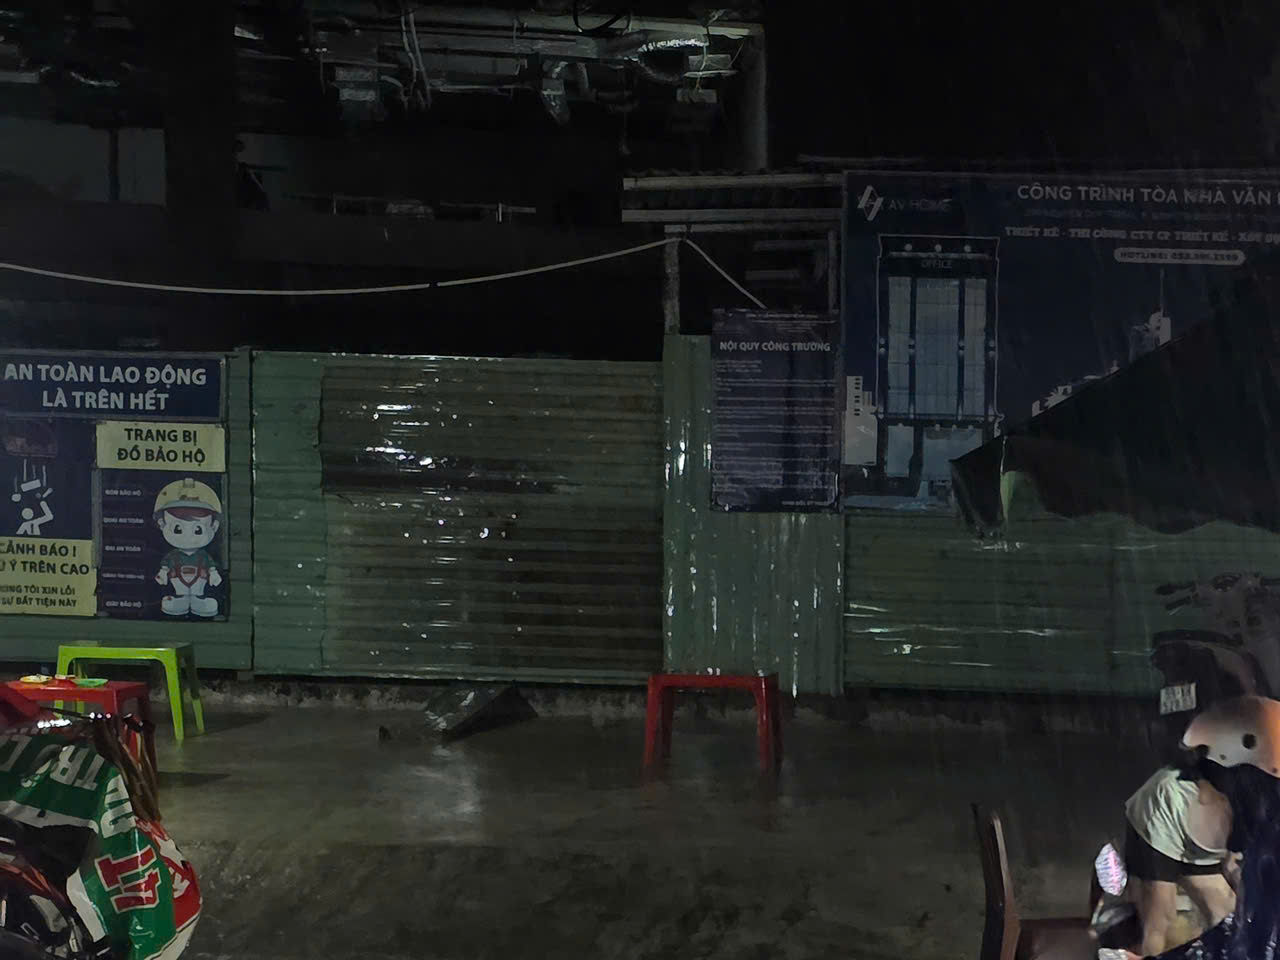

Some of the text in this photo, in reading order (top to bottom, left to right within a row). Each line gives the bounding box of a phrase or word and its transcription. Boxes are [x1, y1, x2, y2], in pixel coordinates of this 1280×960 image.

[1017, 182, 1072, 201] CÔNG
[1077, 183, 1135, 203] TRÌNH
[1139, 185, 1178, 204] TÒA
[1183, 186, 1226, 204] NHÀ
[1231, 187, 1272, 206] VĂN
[719, 340, 738, 353] NỘI
[739, 341, 761, 352] QUY
[761, 341, 790, 352] CÔNG
[4, 361, 208, 389] AN TOÀN LAO ĐỘNG
[42, 386, 170, 411] LÀ TRÊN HẾT
[124, 428, 197, 446] TRANG BỊ
[145, 445, 178, 463] BẢO
[182, 448, 206, 467] HỘ
[40, 543, 69, 557] BÁO
[21, 560, 57, 575] TRÊN
[60, 563, 90, 576] CAO
